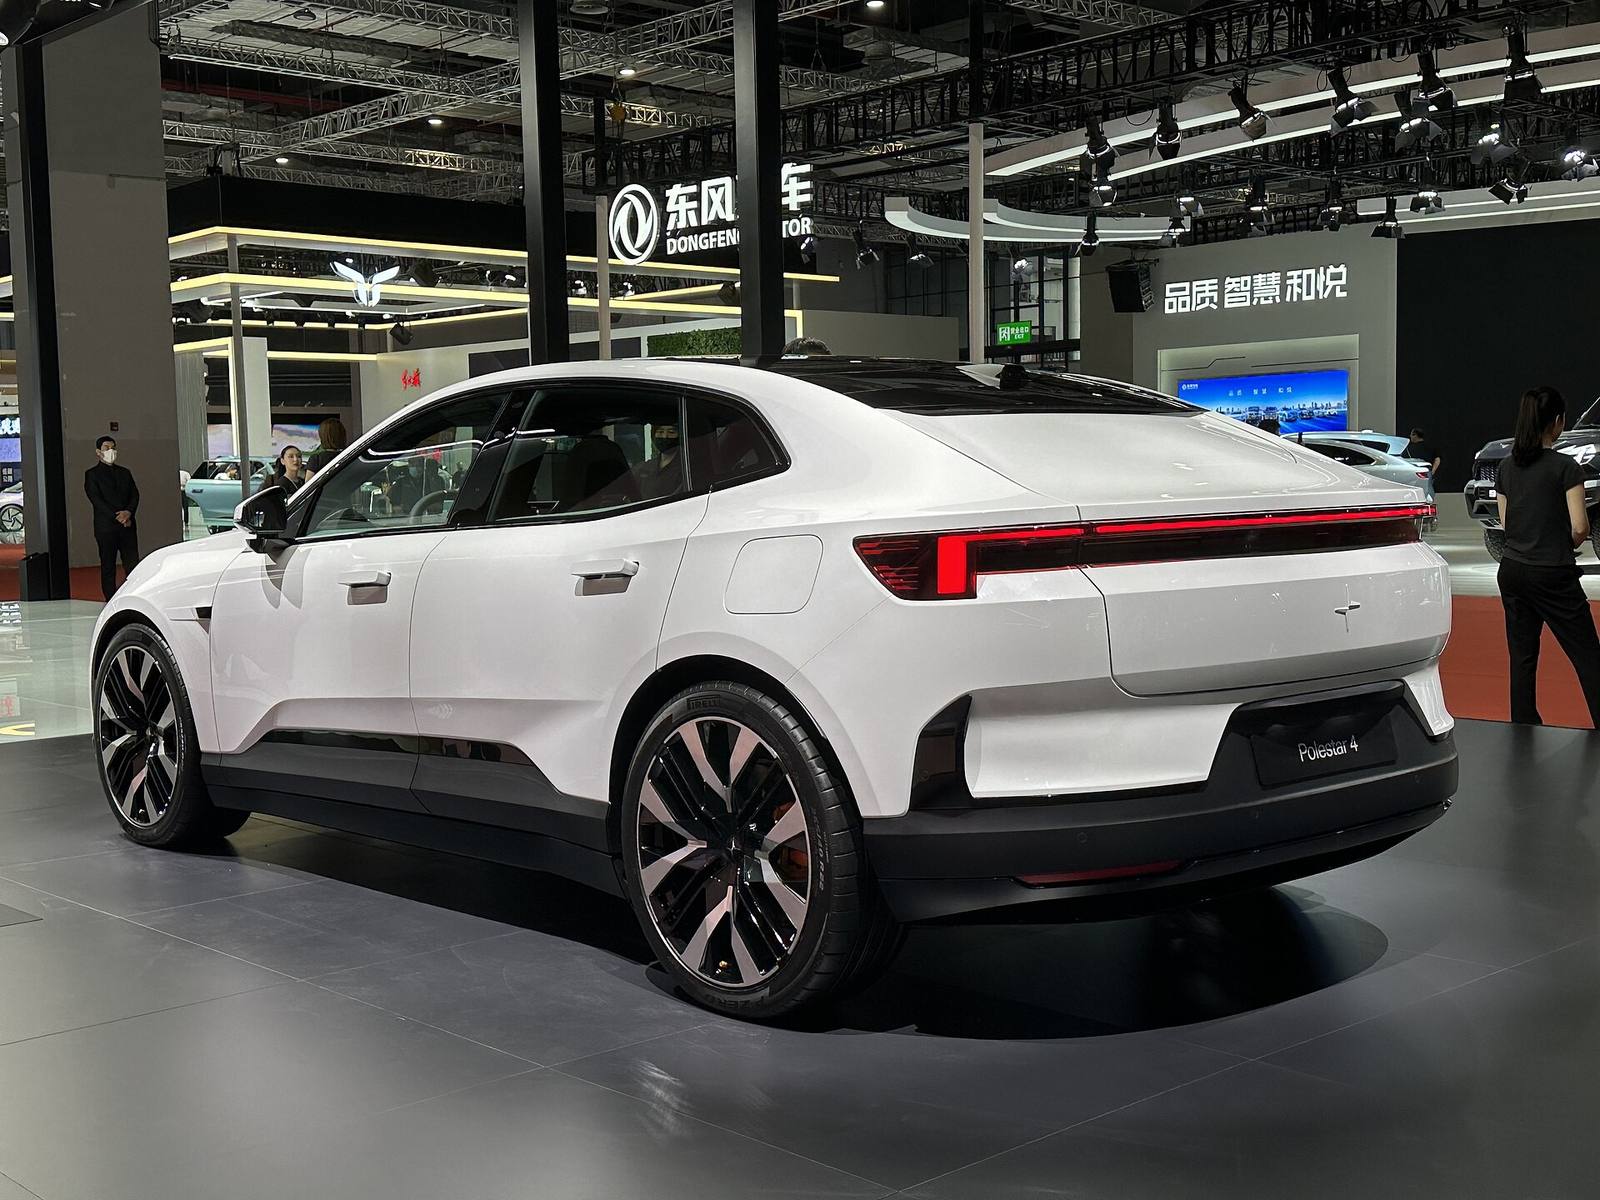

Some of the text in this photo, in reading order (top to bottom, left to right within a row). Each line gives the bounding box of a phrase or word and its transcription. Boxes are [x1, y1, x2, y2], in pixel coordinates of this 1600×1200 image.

[782, 217, 812, 238] TOR
[1164, 264, 1348, 314] 品质 智慧 和悦
[1298, 735, 1359, 762] Polestar 4
